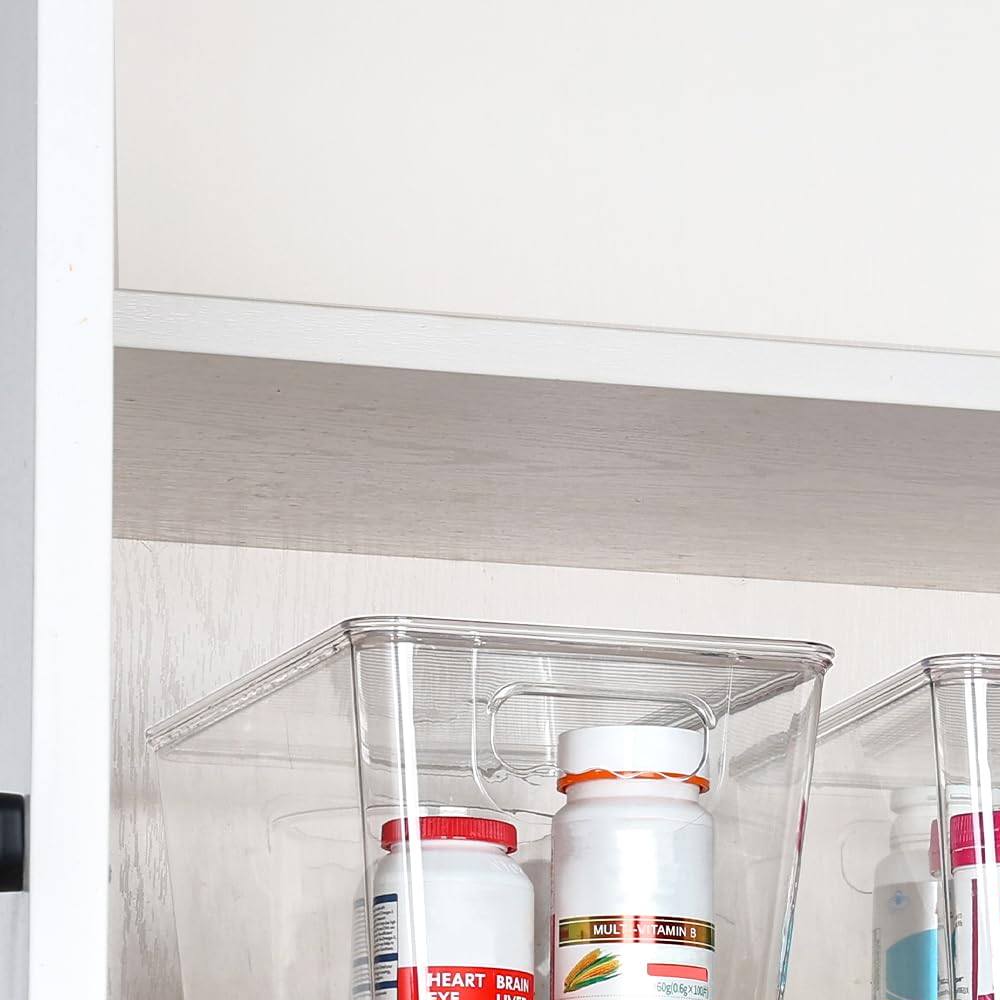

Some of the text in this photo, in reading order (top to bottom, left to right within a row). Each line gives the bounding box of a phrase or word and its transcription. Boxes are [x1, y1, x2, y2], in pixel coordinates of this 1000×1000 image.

[593, 924, 697, 938] MULT-VITAMIN B
[427, 973, 529, 993] HEART BRAIN
